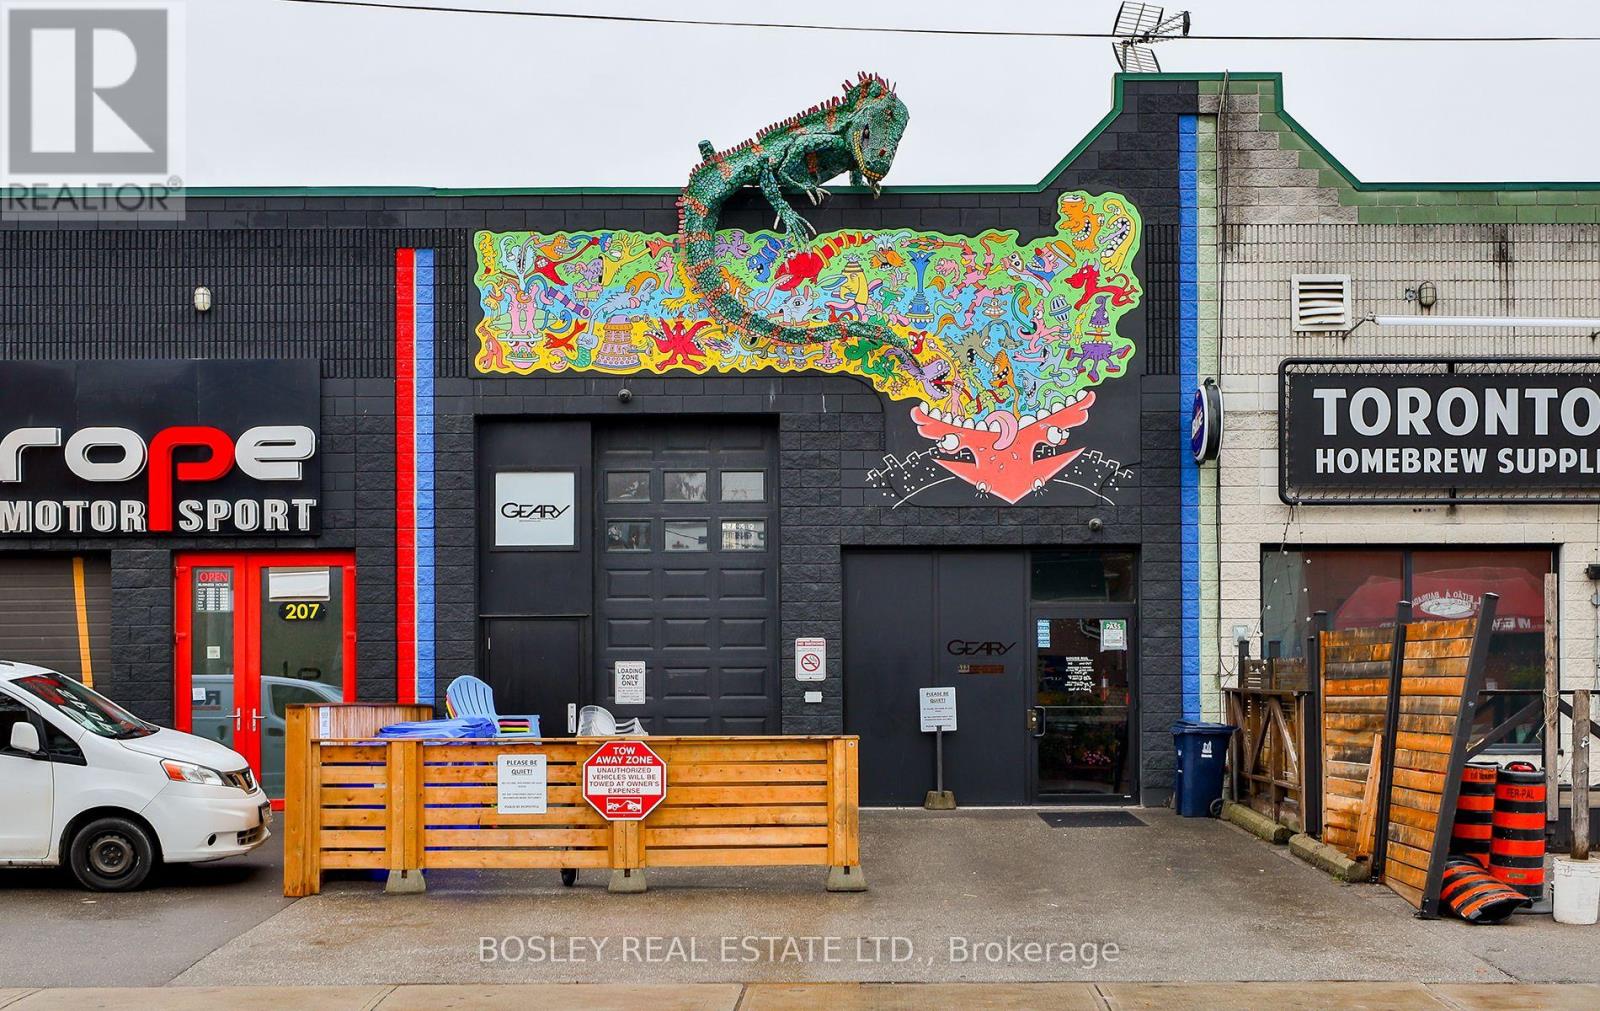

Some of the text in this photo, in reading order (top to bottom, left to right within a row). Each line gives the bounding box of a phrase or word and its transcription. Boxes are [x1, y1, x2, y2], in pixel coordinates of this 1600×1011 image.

[1313, 387, 1600, 436] TORONTO
[1316, 448, 1487, 474] HOMEBREW
[0, 498, 317, 533] MOTOR SPORT
[501, 502, 571, 519] GEARY
[199, 572, 228, 583] OPEN
[285, 603, 320, 620] 207
[947, 639, 1017, 656] GEARY
[613, 747, 635, 755] TOW
[596, 756, 653, 764] AWAY ZONE
